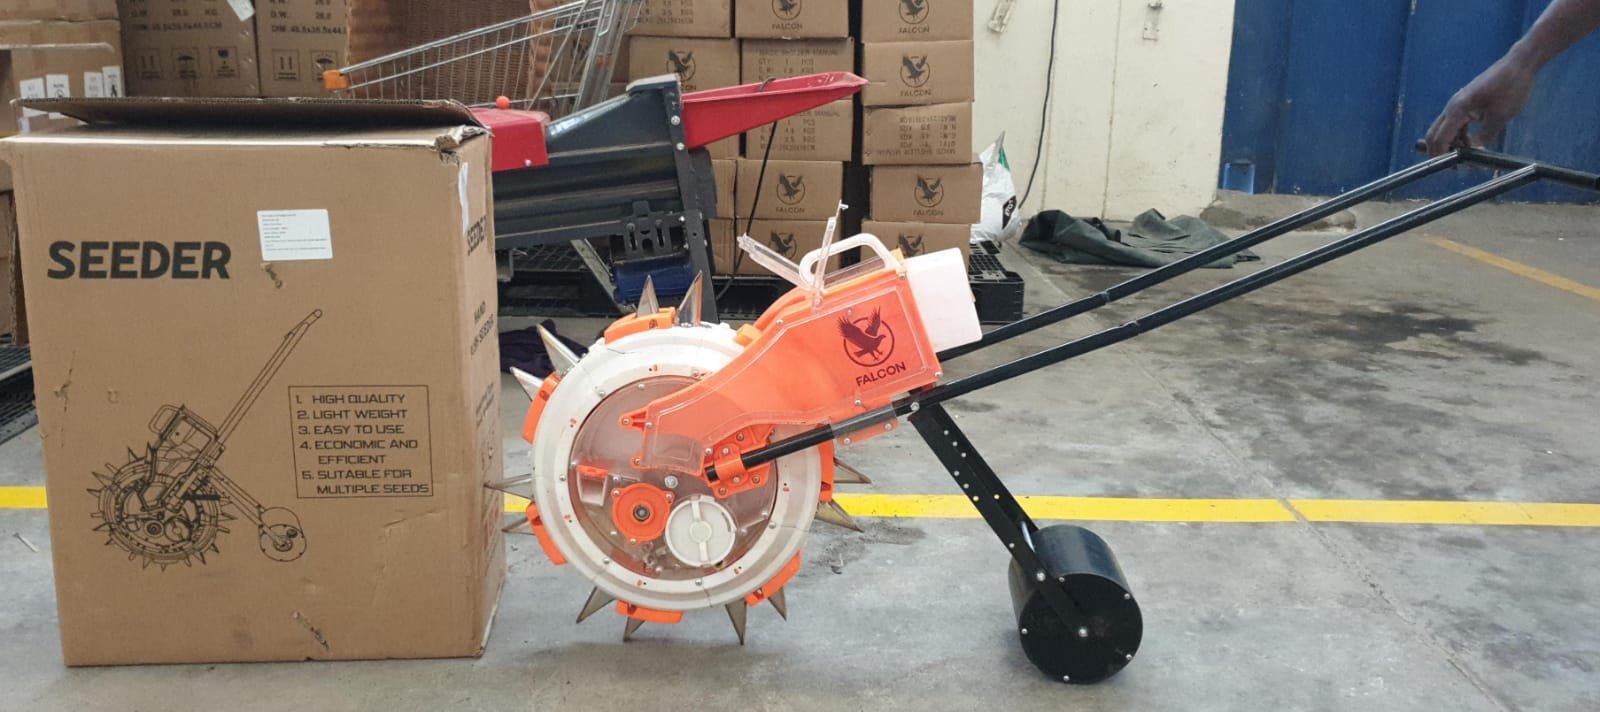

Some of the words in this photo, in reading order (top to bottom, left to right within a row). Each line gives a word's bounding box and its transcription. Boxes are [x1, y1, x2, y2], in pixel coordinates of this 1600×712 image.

[899, 26, 930, 34] FALCON
[900, 89, 932, 97] FALCON
[776, 206, 805, 214] FALCON
[47, 240, 231, 279] SEEDER
[856, 362, 906, 386] FALCON
[296, 394, 302, 404] 1.
[312, 394, 345, 404] HIGH
[347, 393, 405, 404] QUALITY
[296, 410, 310, 420] 2.
[312, 410, 351, 420] LIGHT
[354, 409, 408, 419] WEIGHT
[298, 425, 311, 435] 3.
[313, 425, 351, 435] EASY
[354, 424, 373, 434] TO
[376, 424, 405, 434] USE
[299, 440, 312, 450] 4.
[315, 440, 386, 450] ECONOMIC
[389, 439, 418, 449] AND
[318, 455, 387, 465] EFFICIENT
[384, 469, 412, 479] FOR
[317, 484, 381, 494] MULTIPLE
[383, 483, 430, 494] SEEDS
